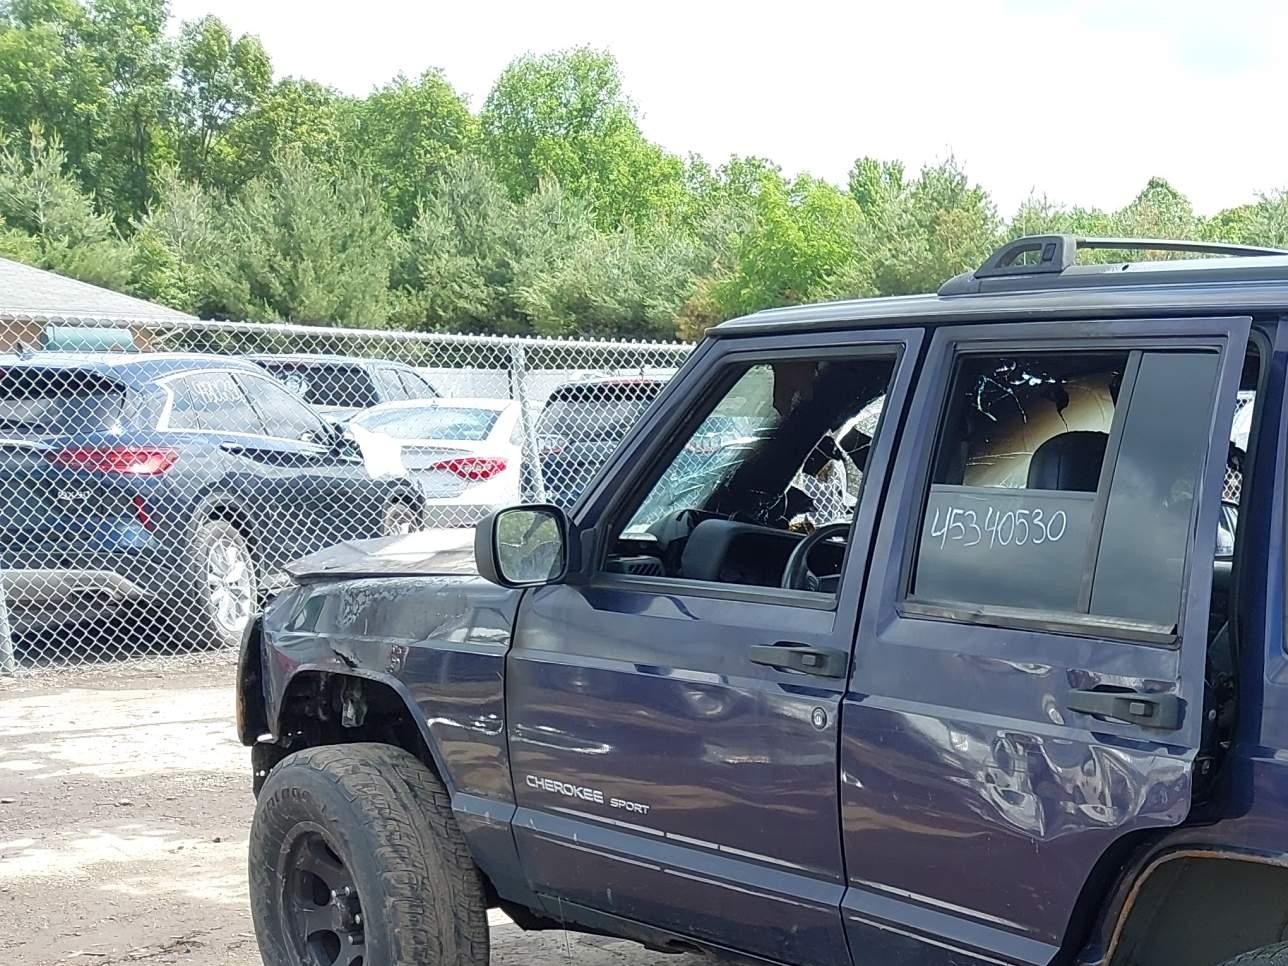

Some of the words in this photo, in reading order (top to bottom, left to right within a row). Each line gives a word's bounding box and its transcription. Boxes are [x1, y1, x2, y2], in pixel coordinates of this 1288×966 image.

[931, 506, 1067, 549] 45340530
[526, 774, 604, 804] CHEROKEE
[610, 798, 650, 814] SPORT
